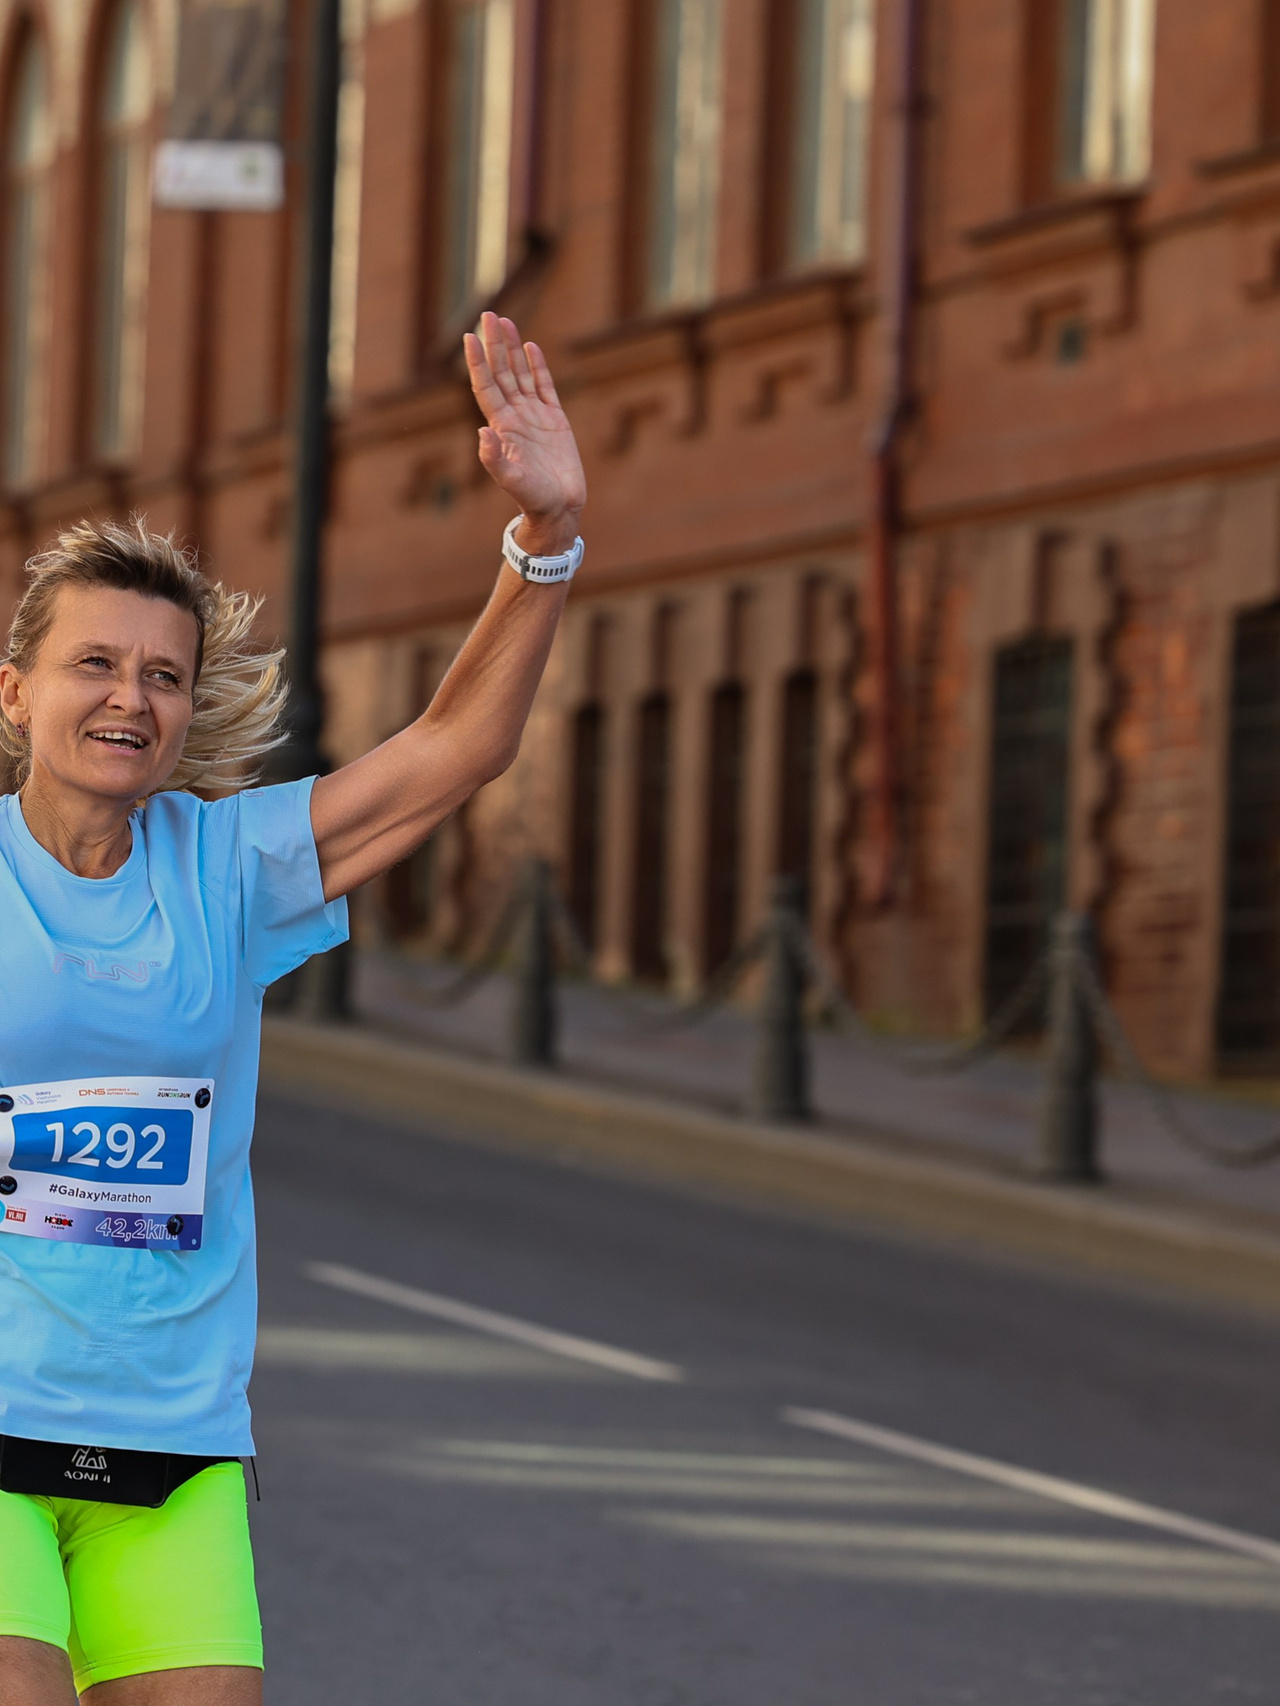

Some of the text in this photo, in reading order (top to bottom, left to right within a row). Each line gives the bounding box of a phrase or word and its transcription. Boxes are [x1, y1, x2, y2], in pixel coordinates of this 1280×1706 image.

[78, 1088, 106, 1096] DNS
[45, 1121, 166, 1170] 1292
[49, 1183, 152, 1204] #GalaxyMarathon
[8, 1210, 25, 1221] VL.RU
